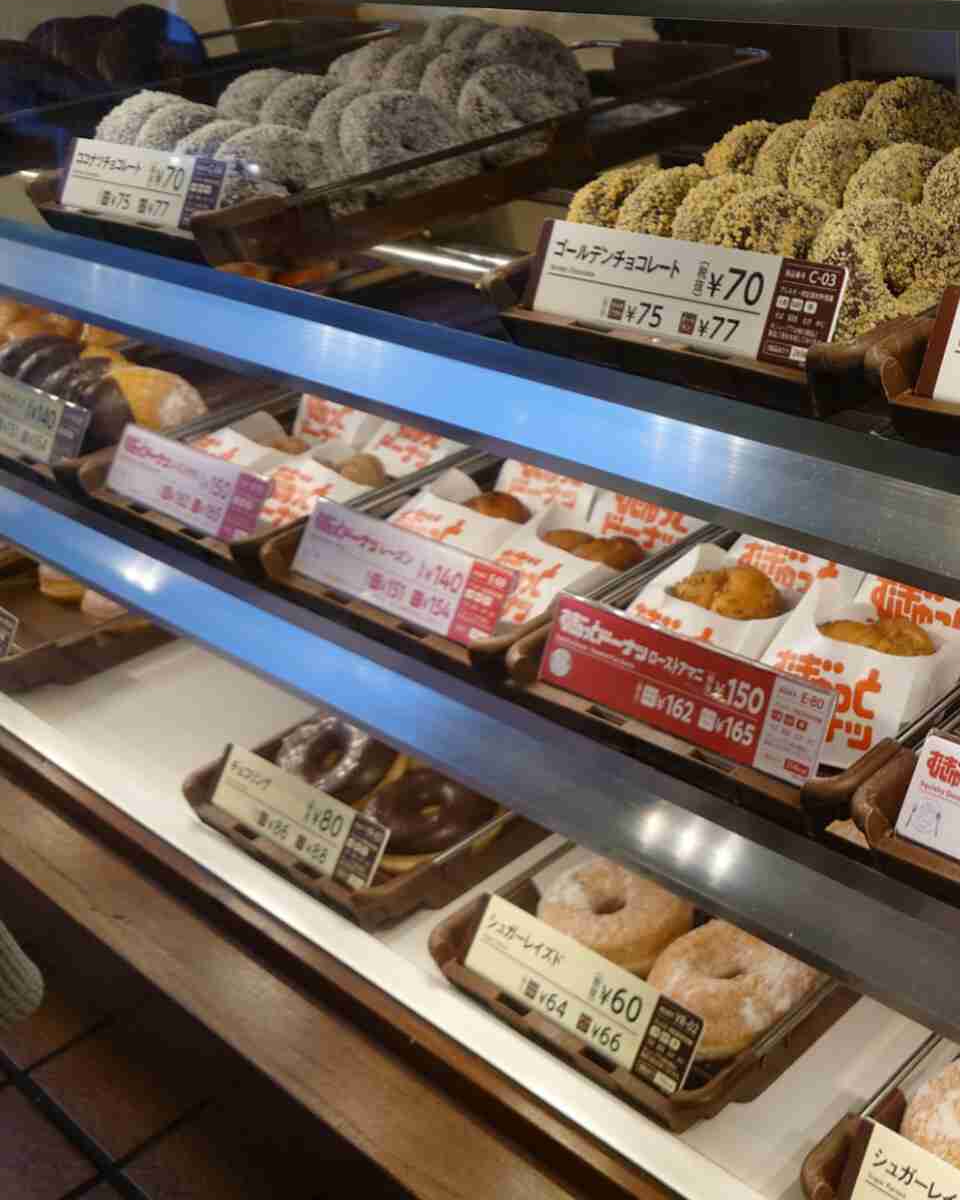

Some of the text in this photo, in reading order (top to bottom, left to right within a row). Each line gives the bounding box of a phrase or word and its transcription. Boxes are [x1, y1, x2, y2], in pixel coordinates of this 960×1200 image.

[553, 240, 681, 279] ゴールデンチョコレート
[808, 269, 838, 288] C-03
[706, 266, 765, 307] ¥70
[626, 301, 741, 343] ¥75 ¥77
[715, 675, 765, 716] ¥150
[658, 690, 694, 725] ¥162
[716, 711, 755, 746] ¥165
[538, 991, 623, 1054] ¥64 ¥66
[597, 985, 644, 1024] ¥60
